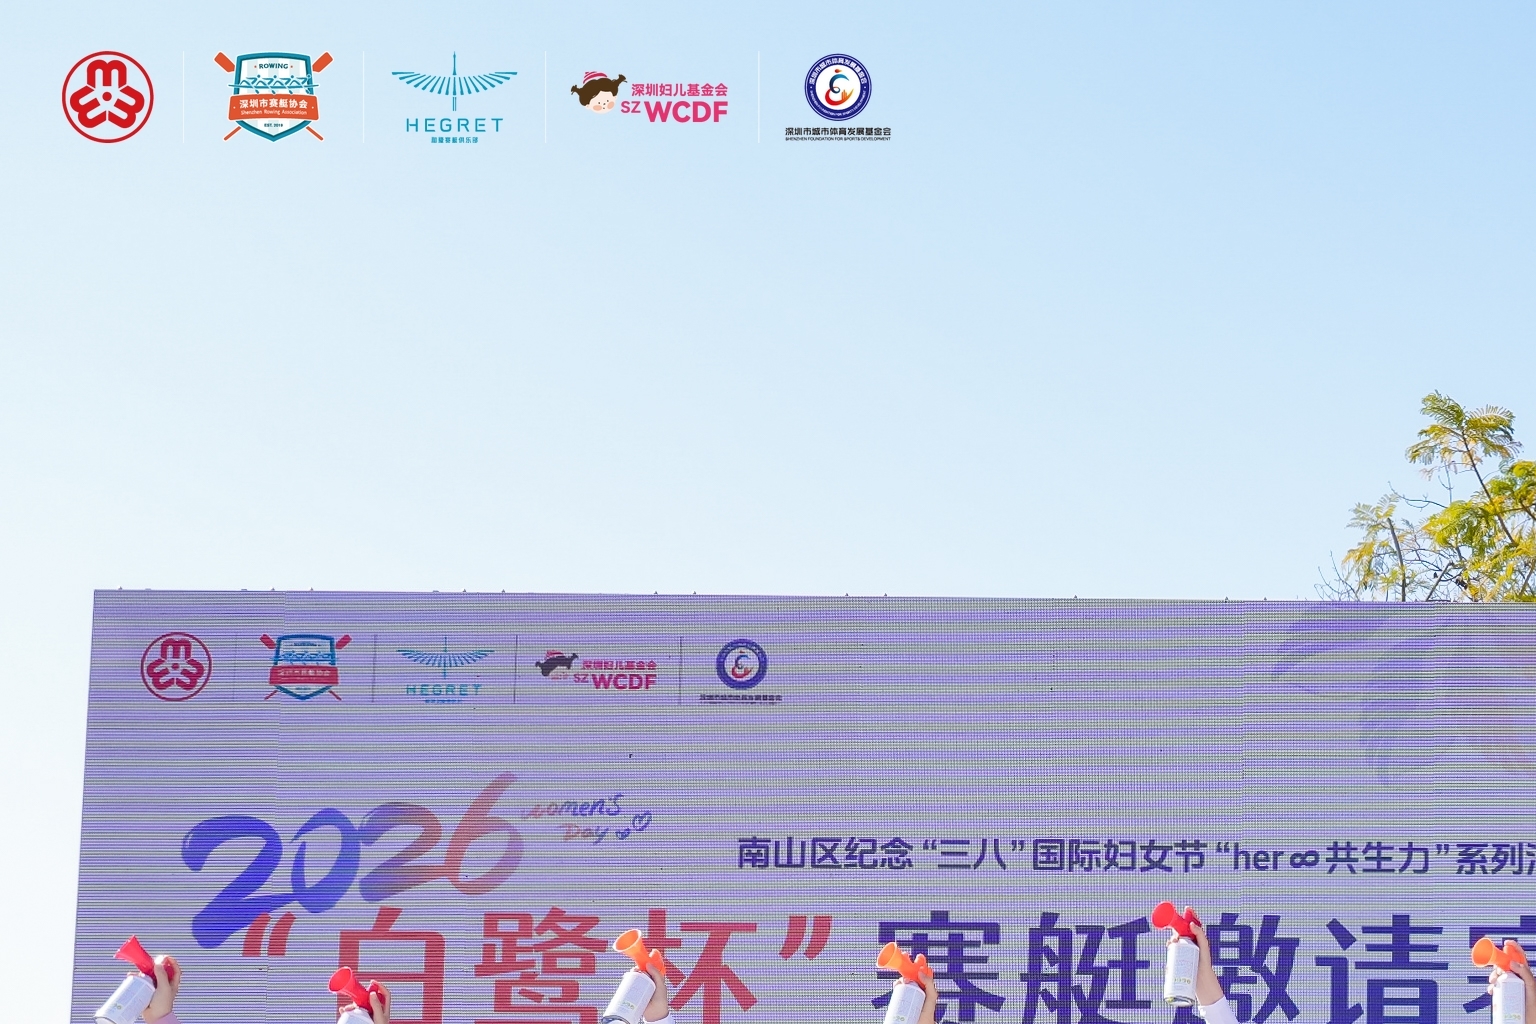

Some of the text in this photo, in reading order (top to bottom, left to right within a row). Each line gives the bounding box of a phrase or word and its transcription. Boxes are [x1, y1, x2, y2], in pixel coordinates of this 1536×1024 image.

[591, 674, 657, 689] WCDF
[406, 684, 481, 696] HEGRET
[181, 772, 524, 949] 2026
